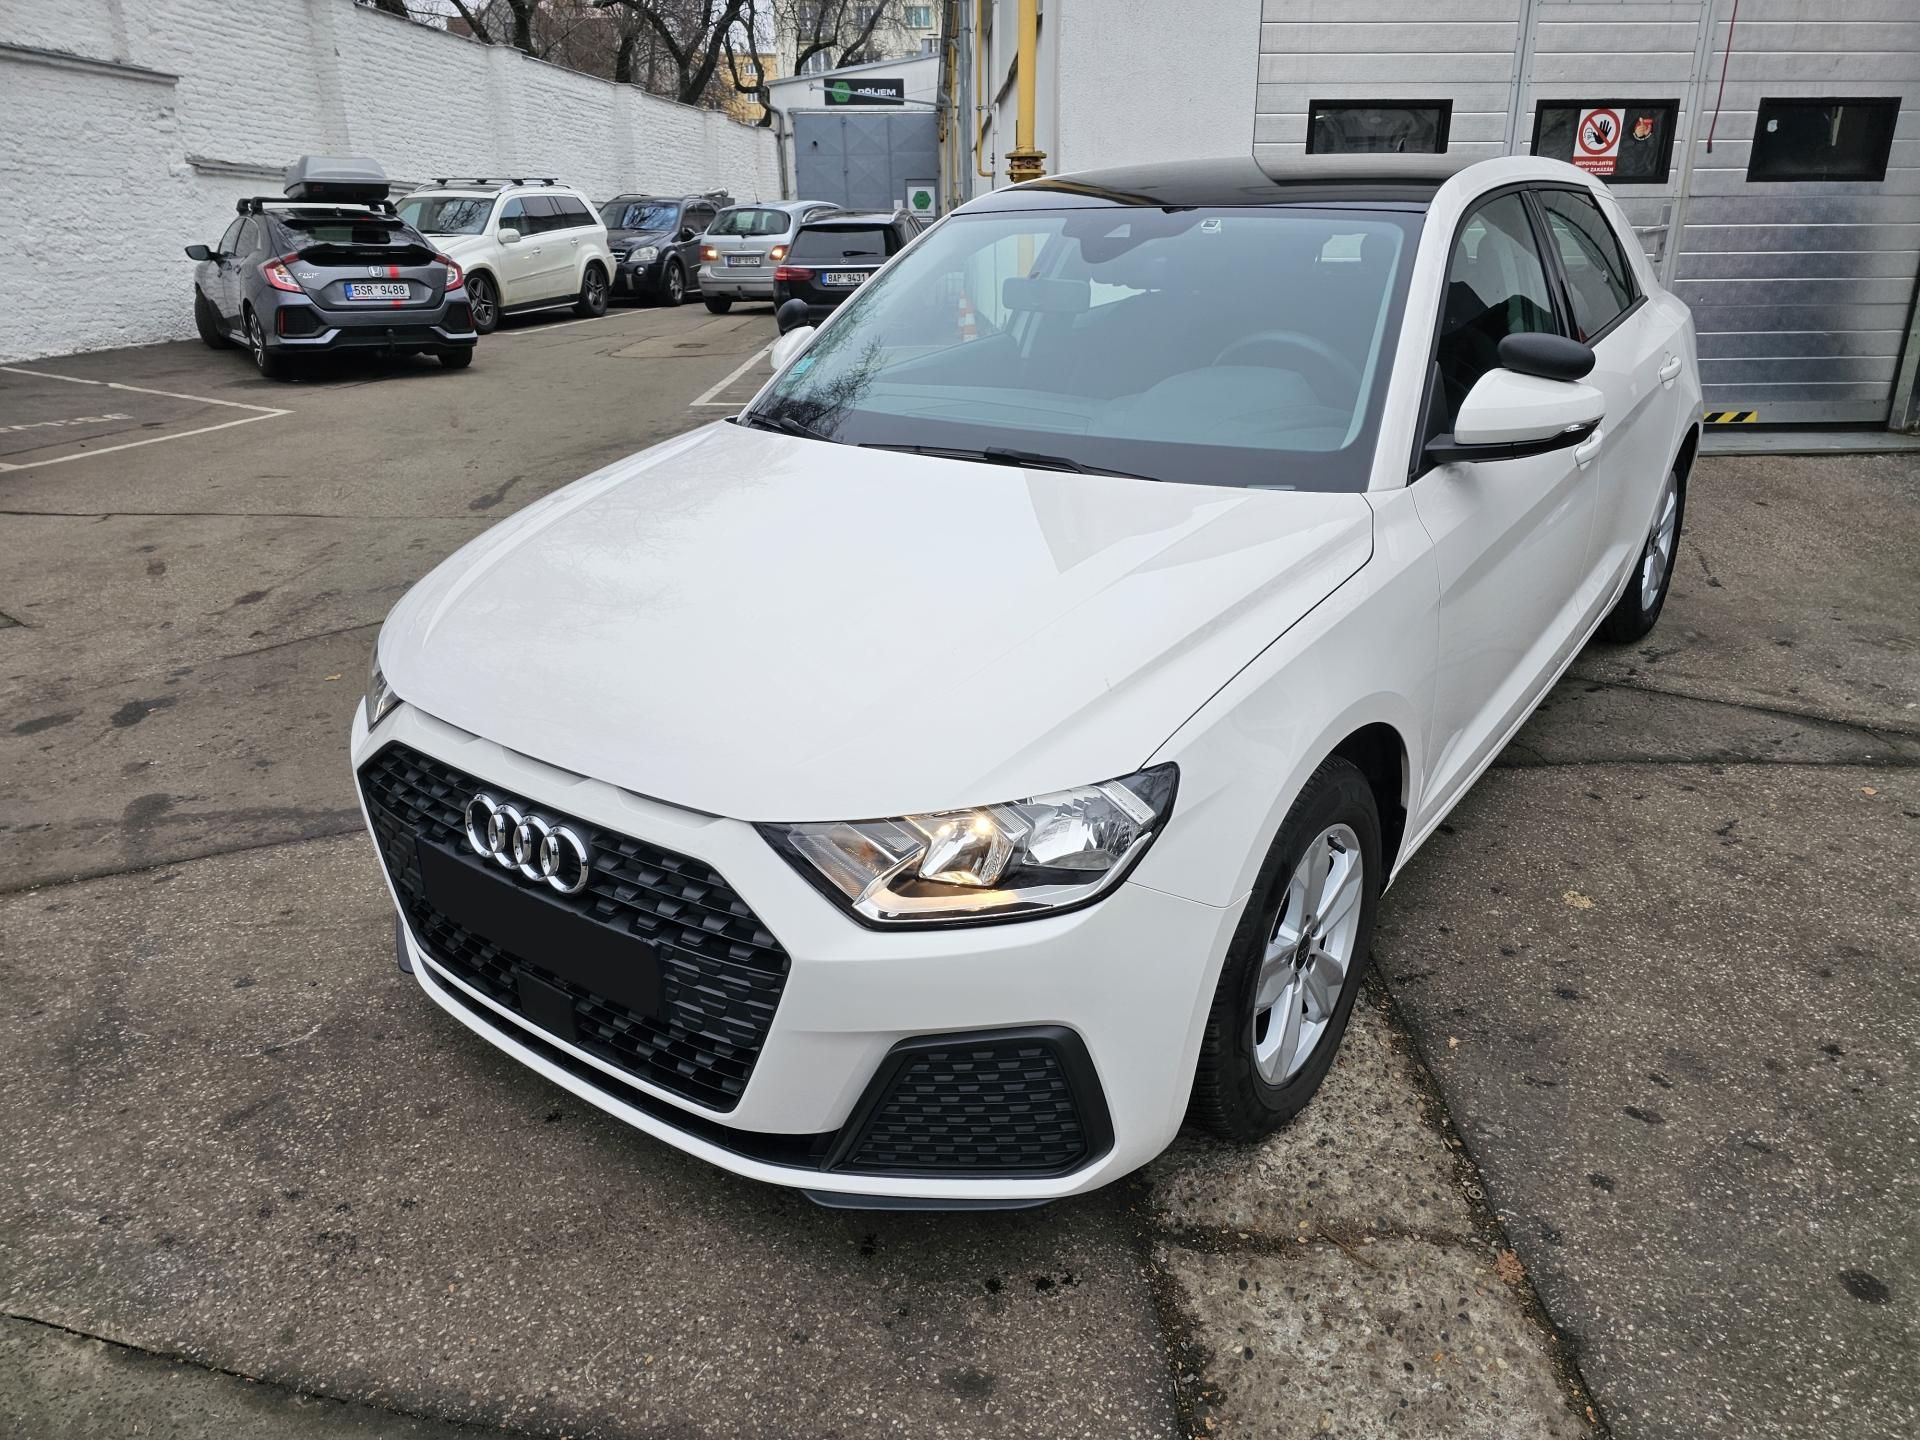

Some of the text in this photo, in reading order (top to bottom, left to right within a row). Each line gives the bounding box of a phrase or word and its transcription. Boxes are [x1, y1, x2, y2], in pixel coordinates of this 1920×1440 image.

[828, 273, 865, 282] 8AP 9431
[353, 285, 405, 295] 5SR 9488
